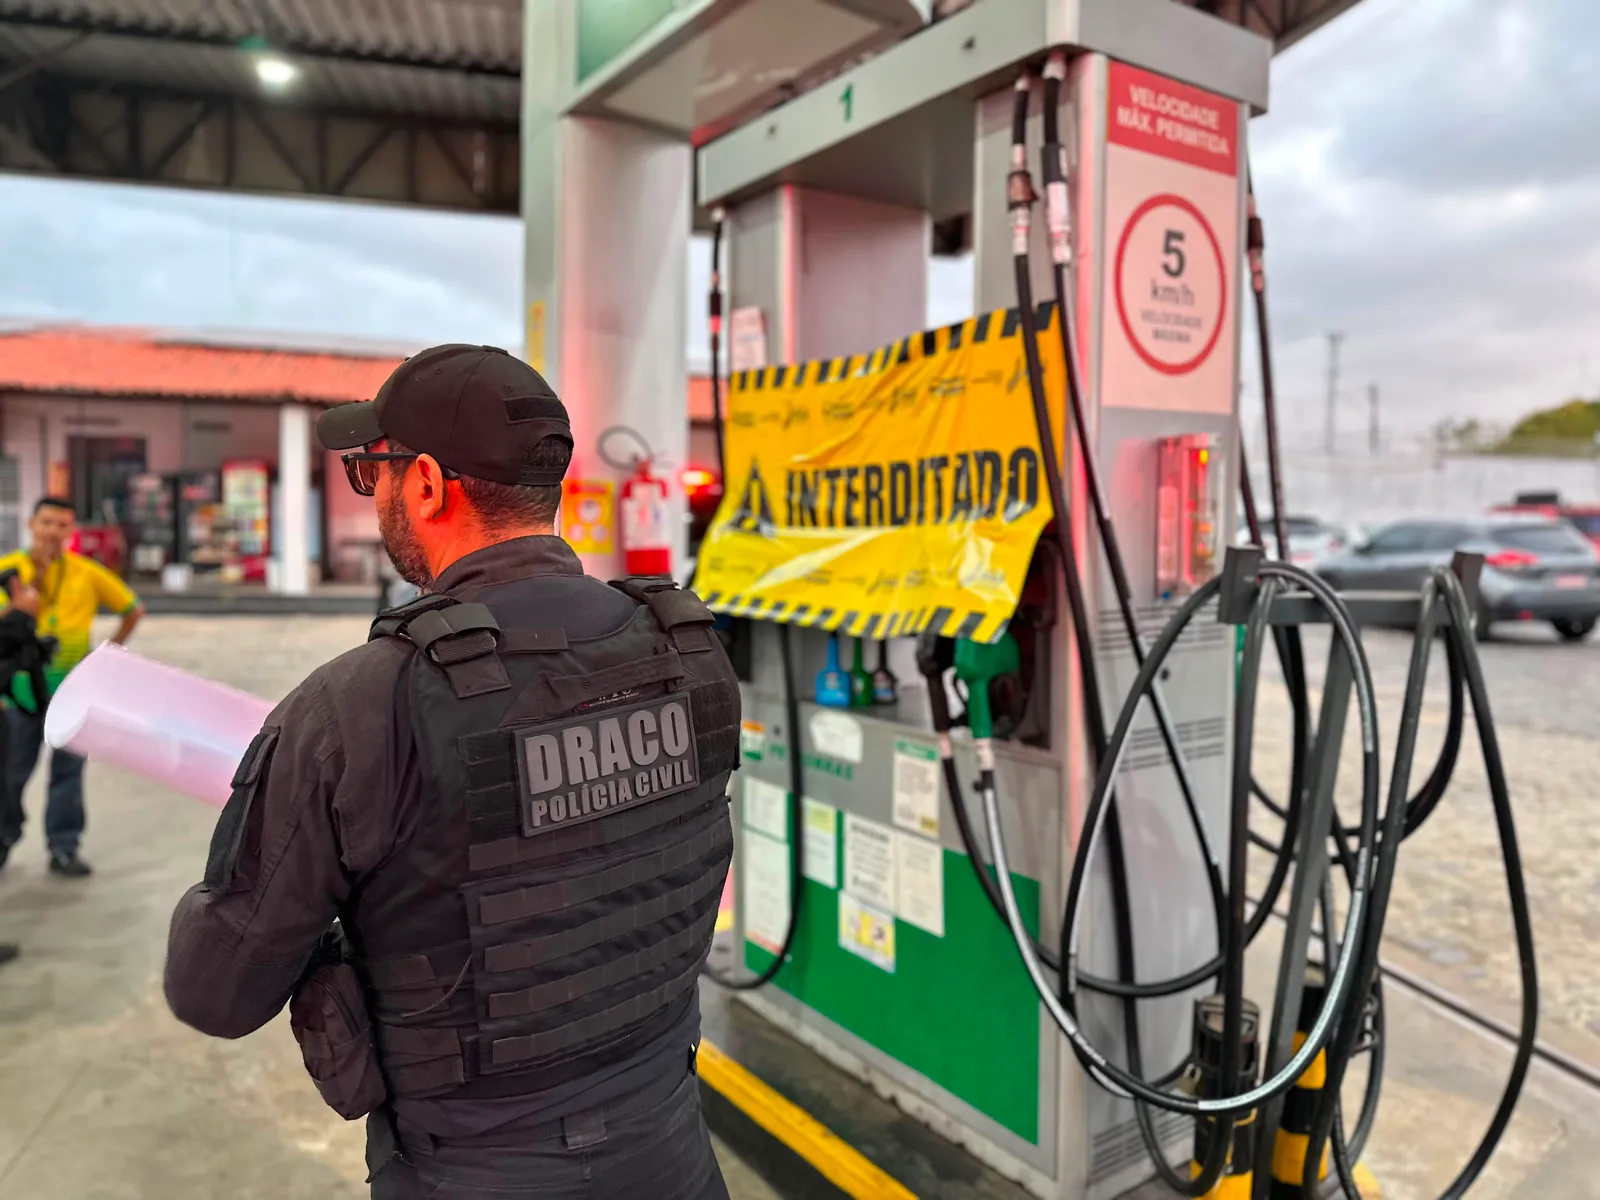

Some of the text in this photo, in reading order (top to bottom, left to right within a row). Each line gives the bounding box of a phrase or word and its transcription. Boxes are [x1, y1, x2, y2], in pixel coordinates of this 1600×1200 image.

[839, 83, 855, 123] 1
[1129, 84, 1219, 131] VELOCIDADE
[1156, 117, 1230, 156] PERMITIDA
[1162, 229, 1186, 279] 5
[1150, 278, 1195, 307] km/h
[784, 447, 1038, 528] INTERDITADO
[525, 703, 690, 795] DRACO
[531, 759, 693, 827] POLÍCIA CIVIL
